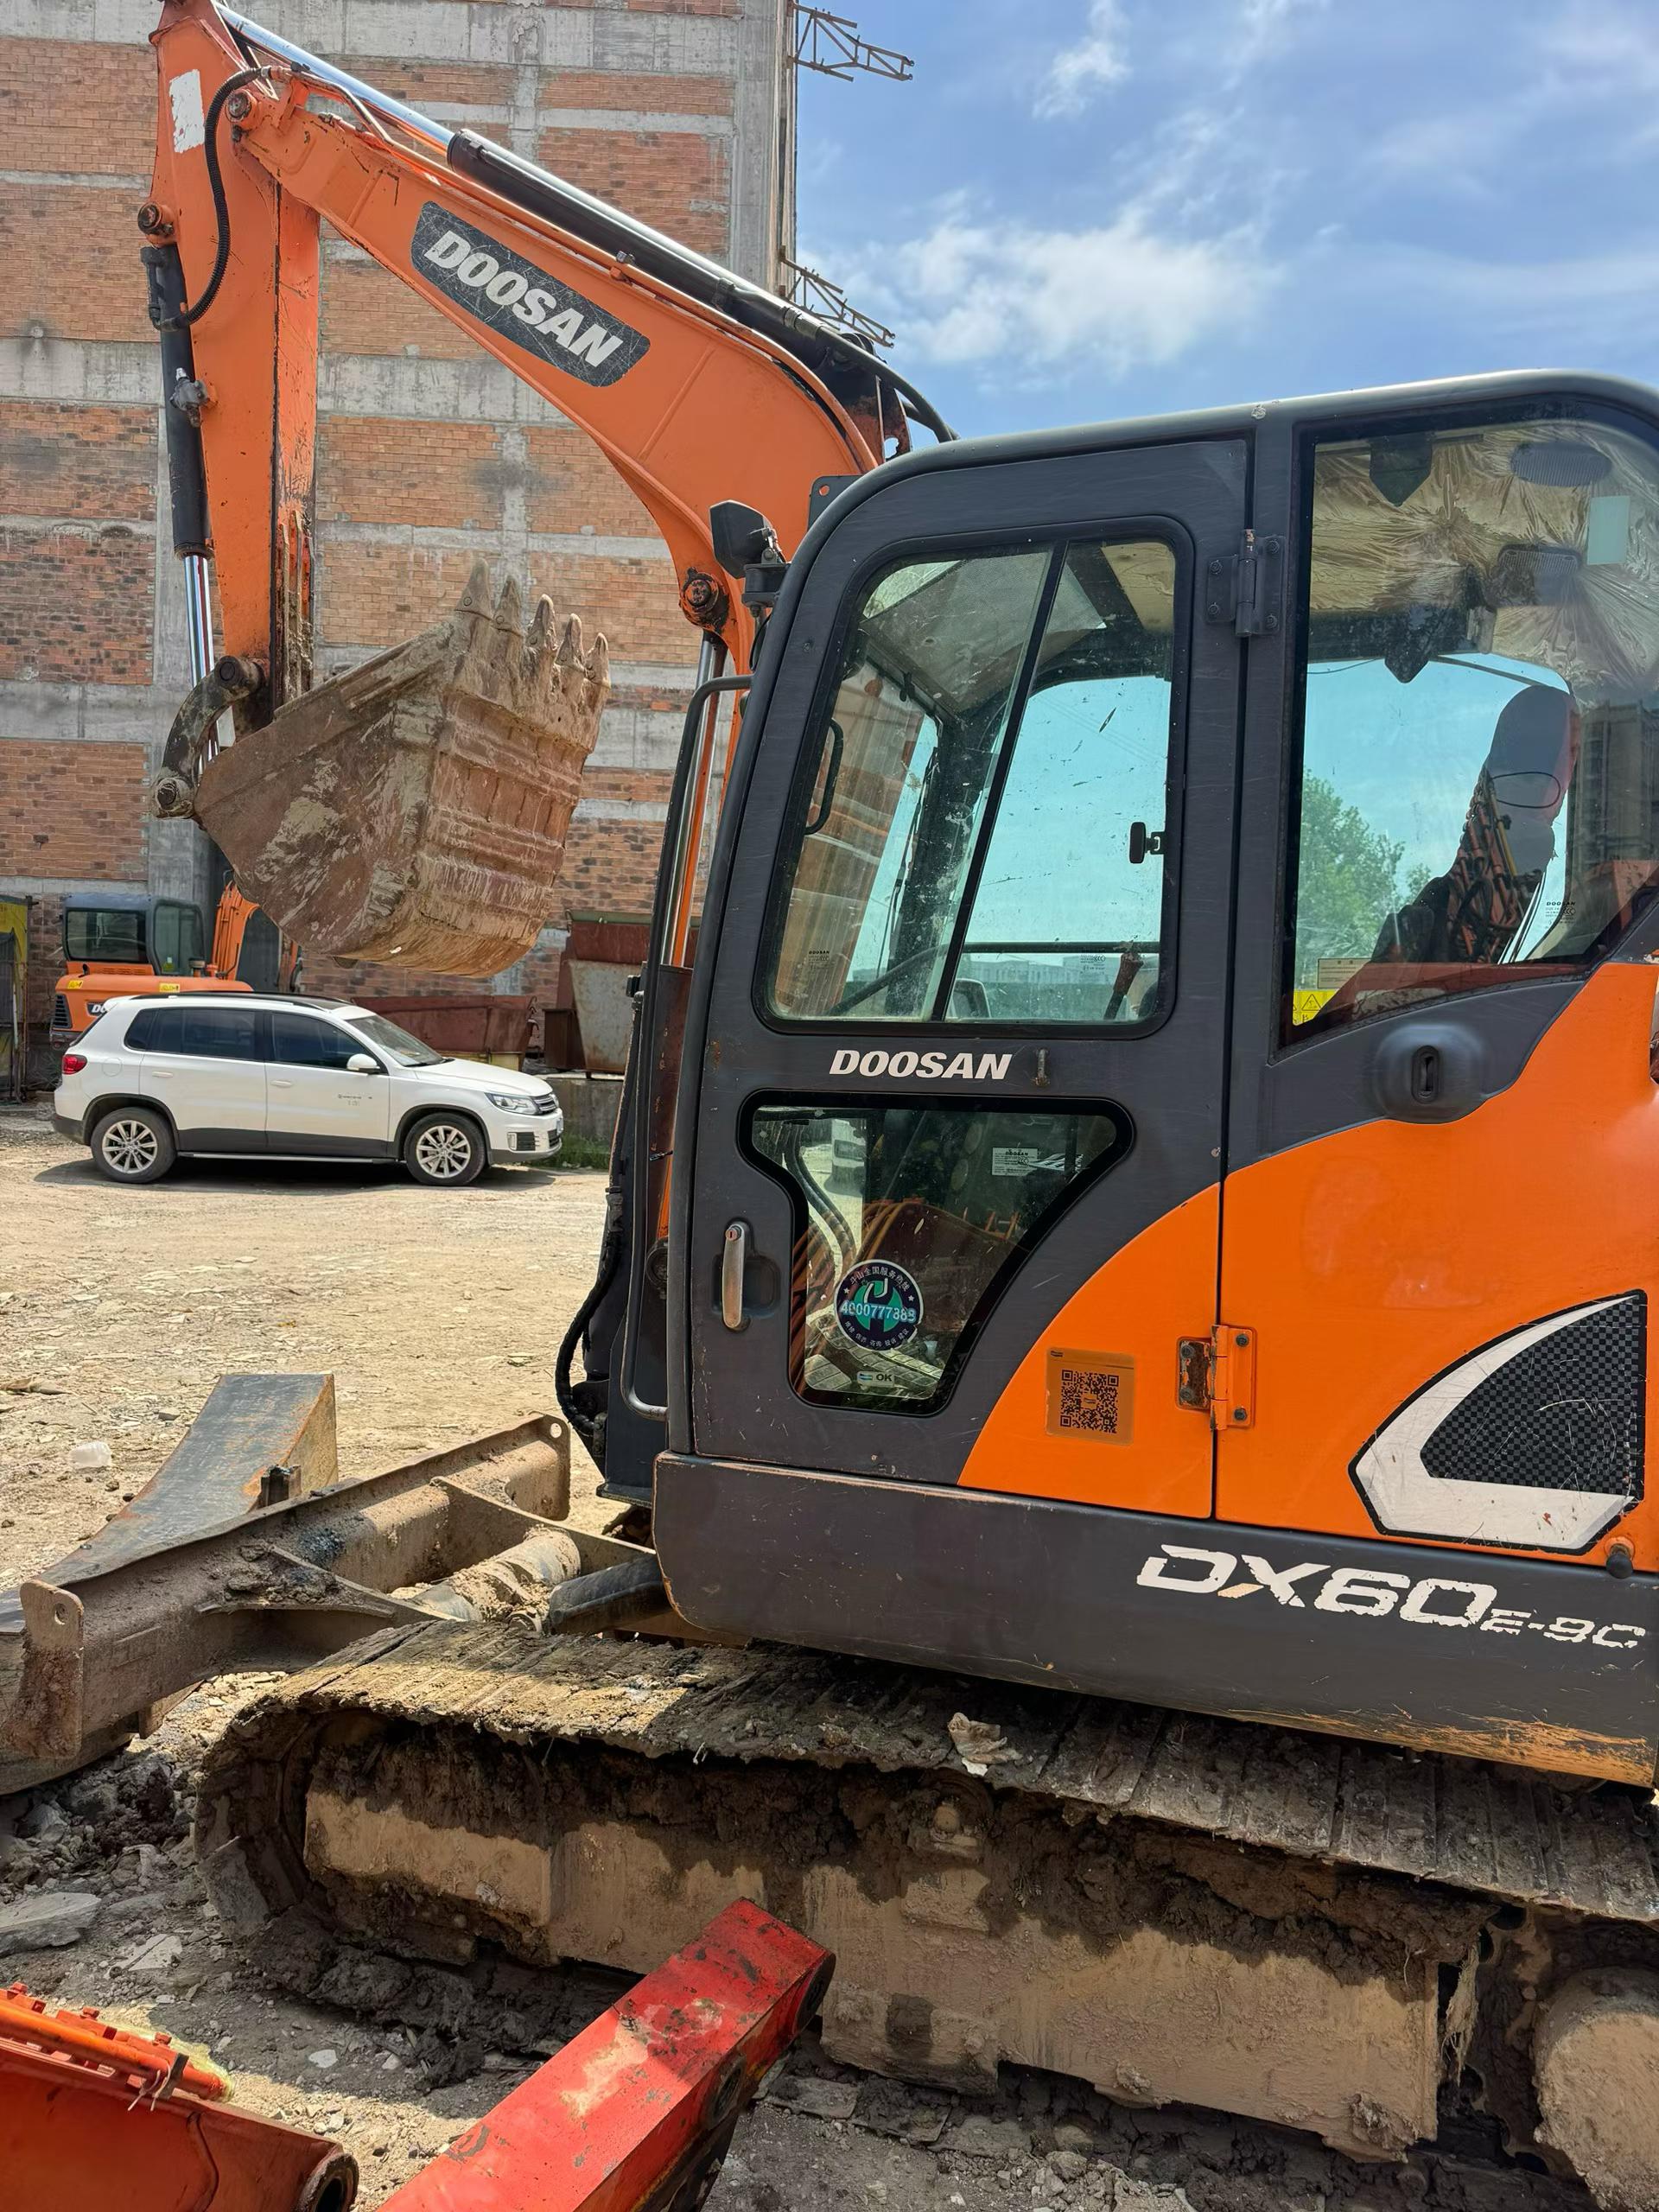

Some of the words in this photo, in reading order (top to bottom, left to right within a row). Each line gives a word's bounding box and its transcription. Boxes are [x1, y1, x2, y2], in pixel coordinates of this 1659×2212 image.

[424, 230, 623, 367] DOOSAN
[829, 1049, 1013, 1080] DOOSAN
[875, 1373, 892, 1382] OK
